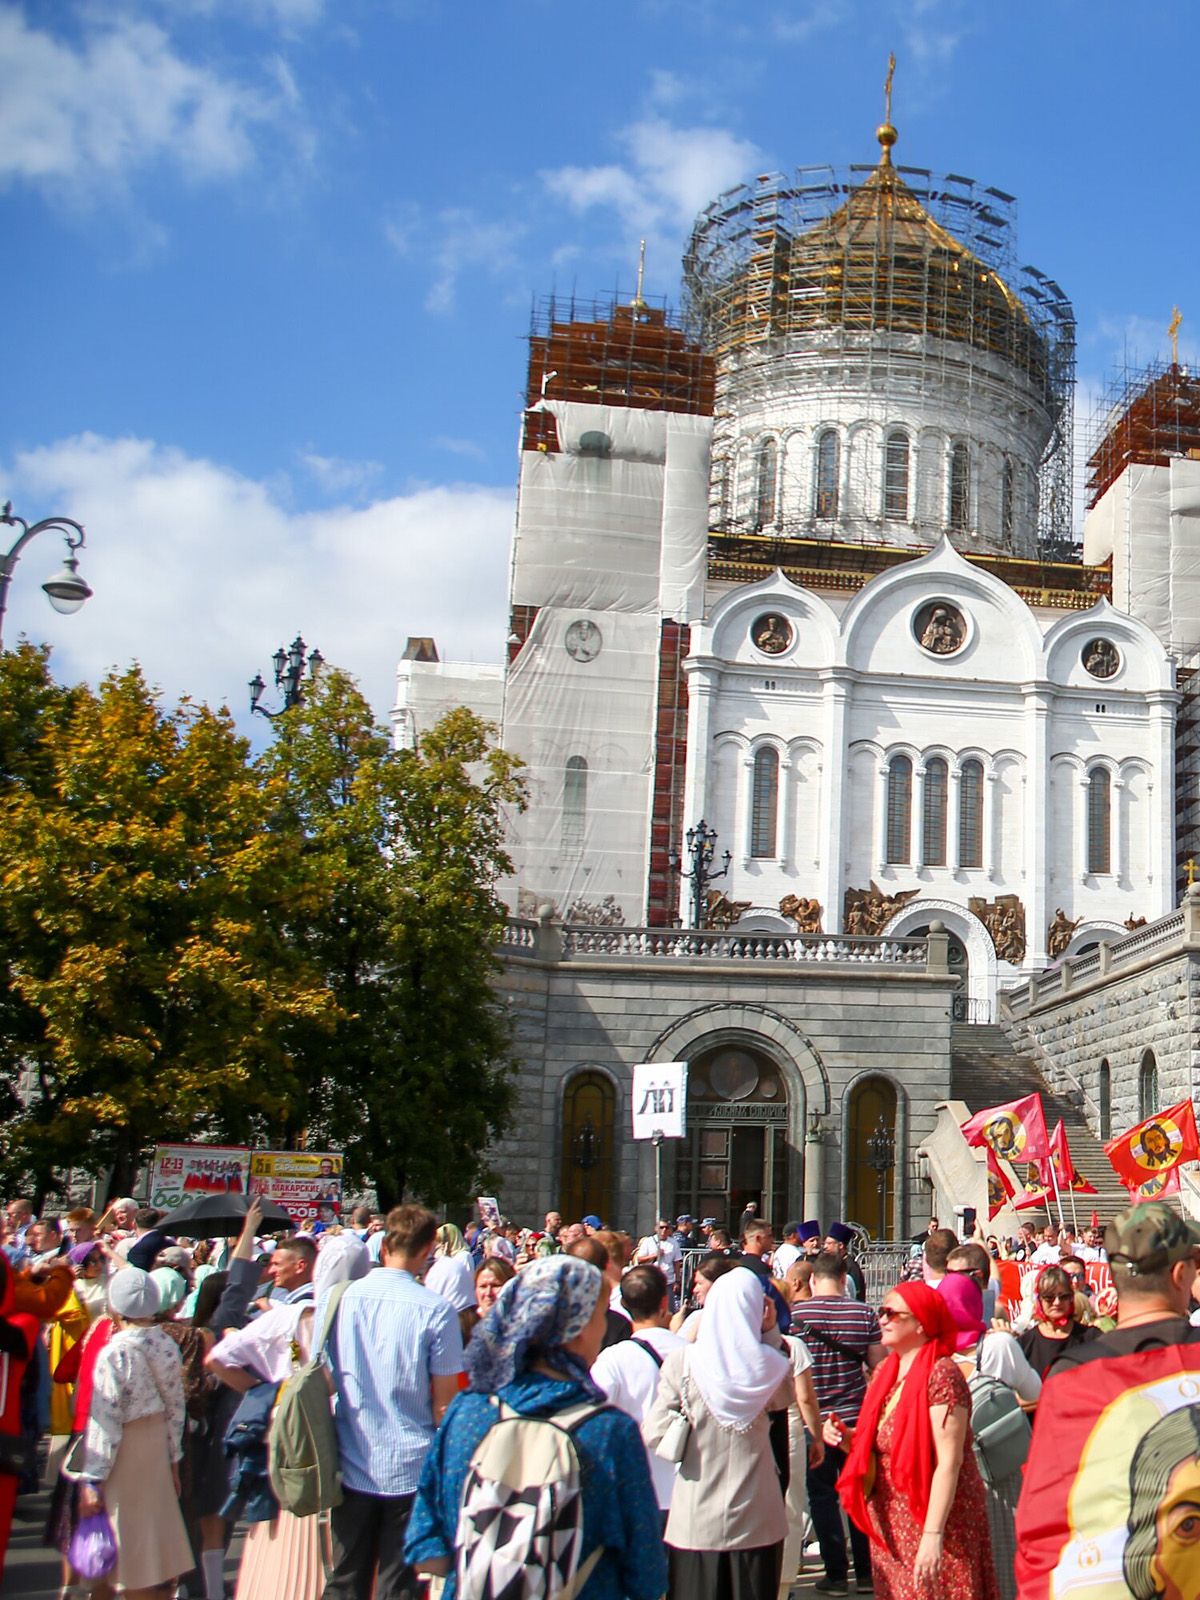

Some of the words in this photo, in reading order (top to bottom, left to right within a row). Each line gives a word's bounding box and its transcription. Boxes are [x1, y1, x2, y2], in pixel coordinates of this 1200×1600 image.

[160, 1157, 184, 1169] 12-13
[272, 1184, 320, 1193] МАКАРСКИЕ
[287, 1207, 319, 1218] РОВ
